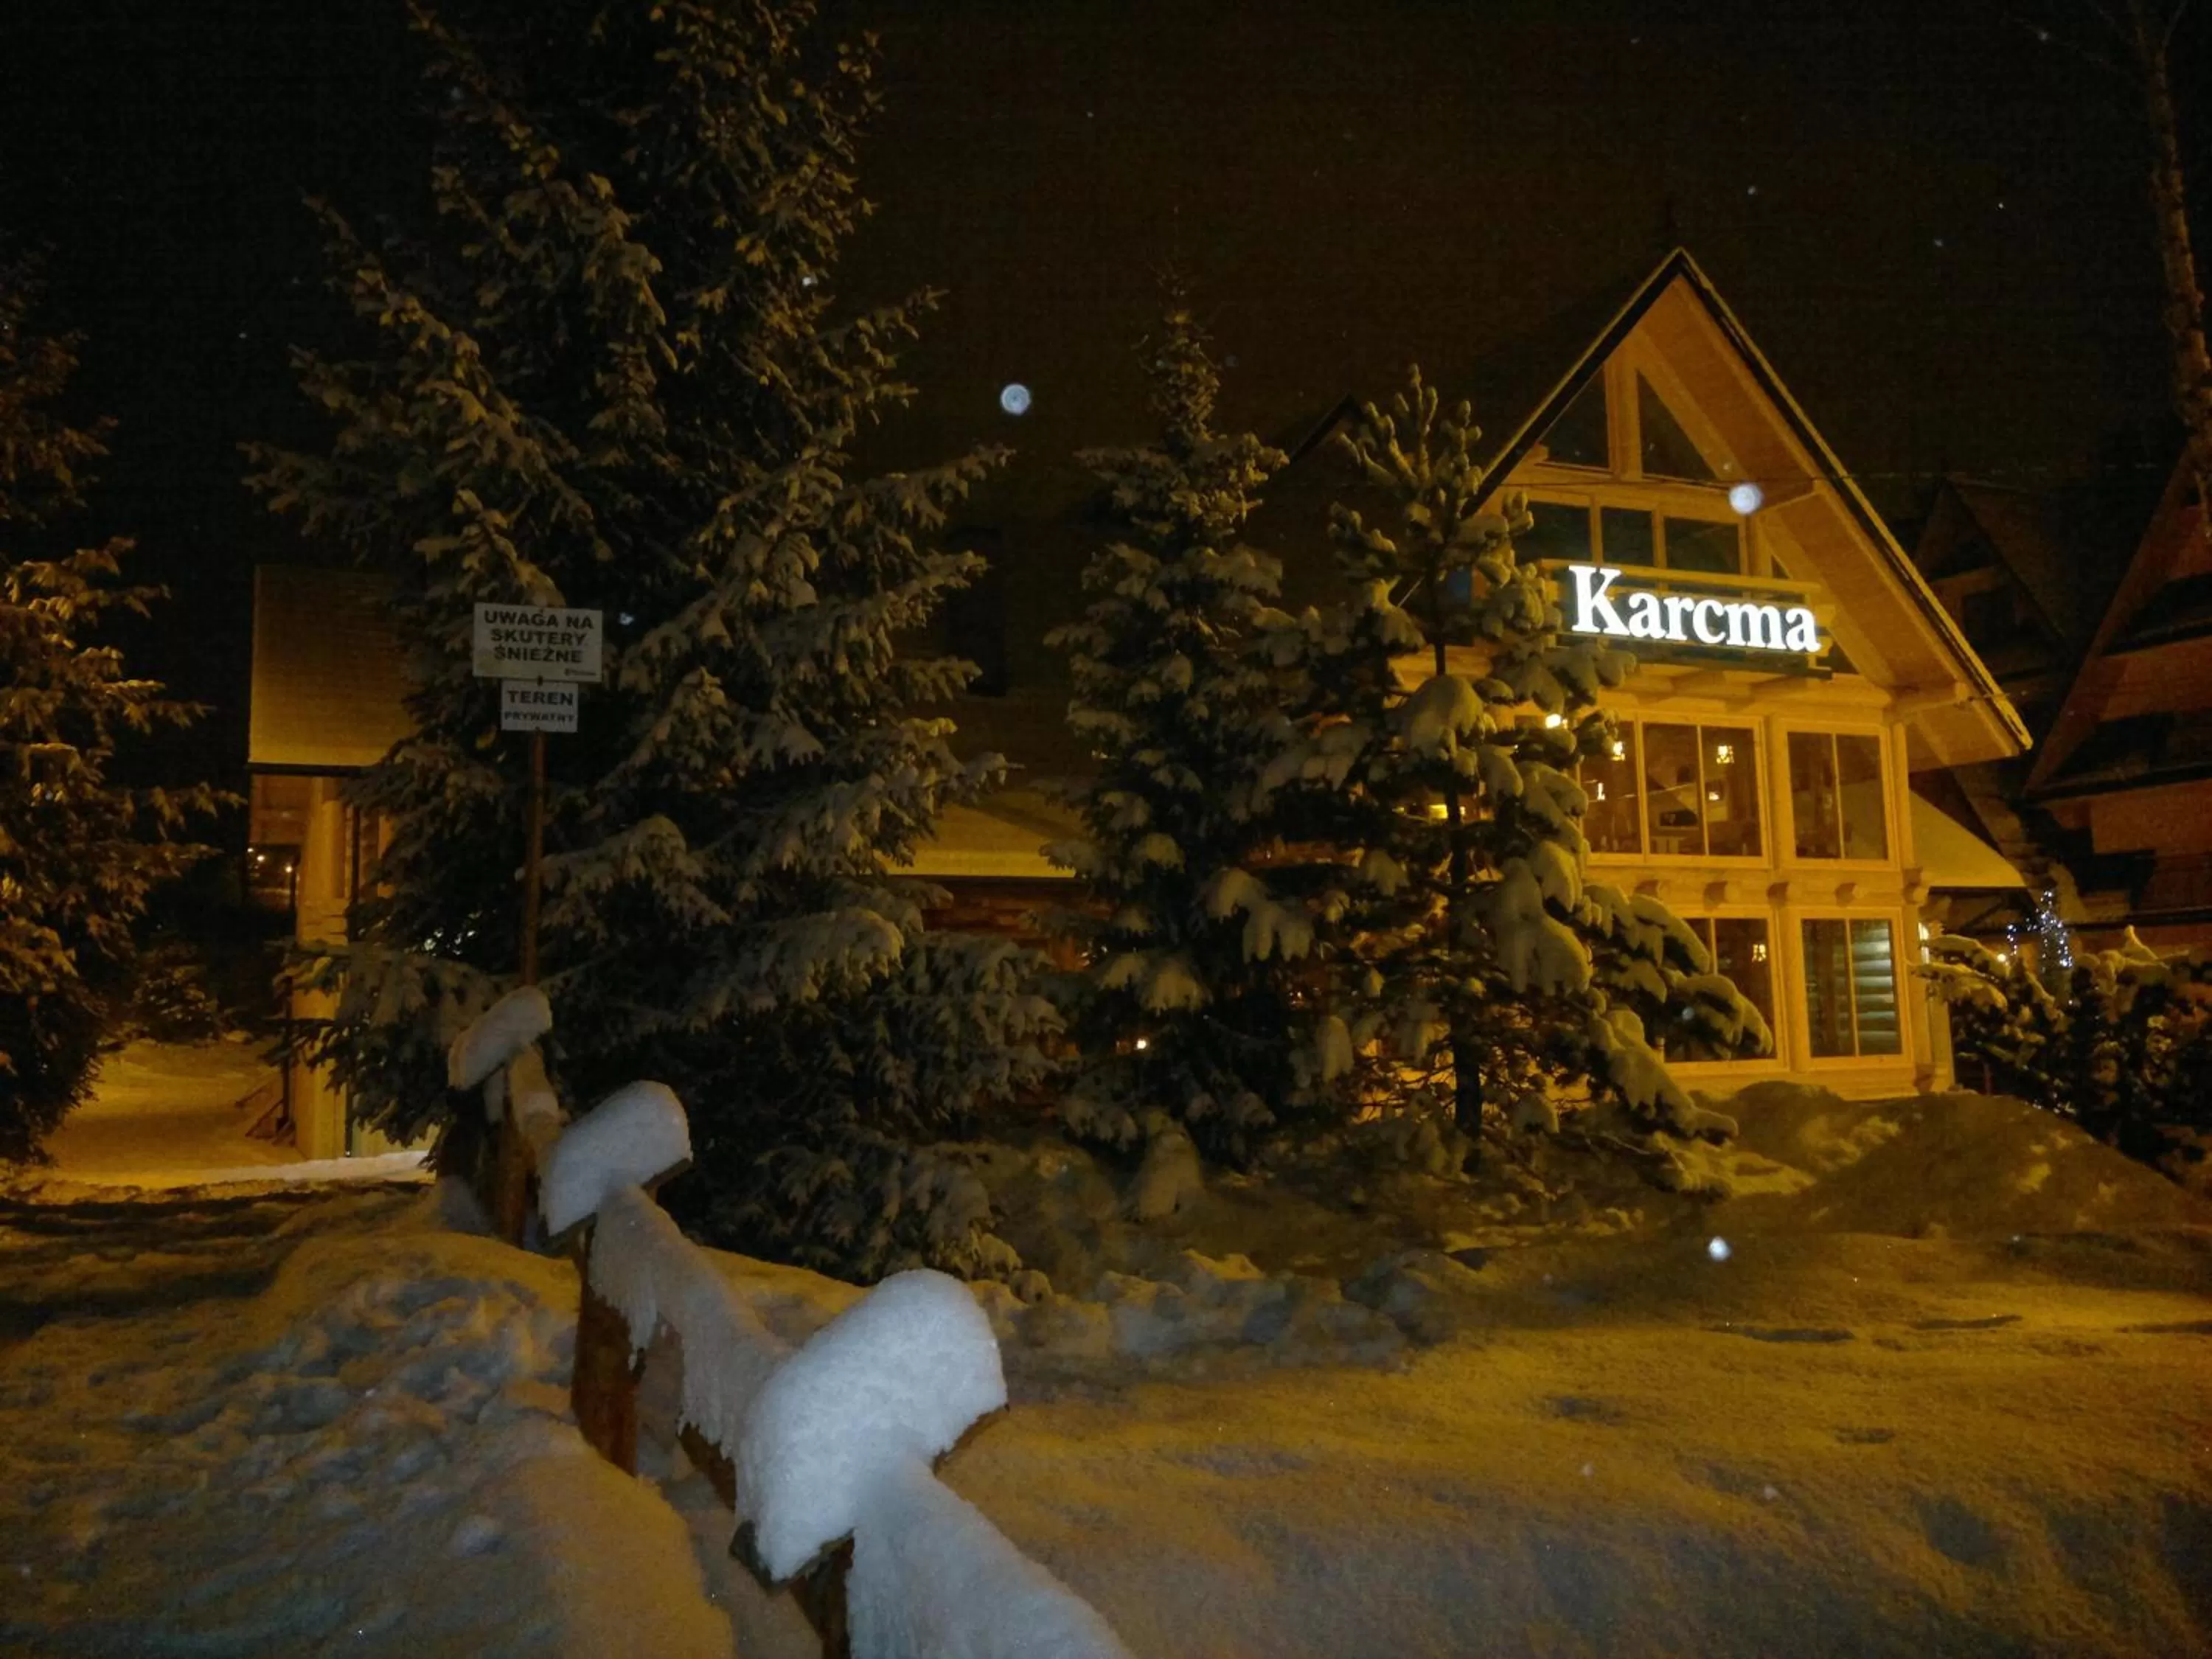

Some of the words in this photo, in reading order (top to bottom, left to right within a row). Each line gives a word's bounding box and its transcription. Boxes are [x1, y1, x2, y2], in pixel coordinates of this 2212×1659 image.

[1568, 565, 1821, 653] Karcma
[484, 610, 559, 628] UWAGA
[566, 615, 594, 629] NA
[491, 628, 587, 646] SKUTERY
[507, 690, 574, 706] TEREN
